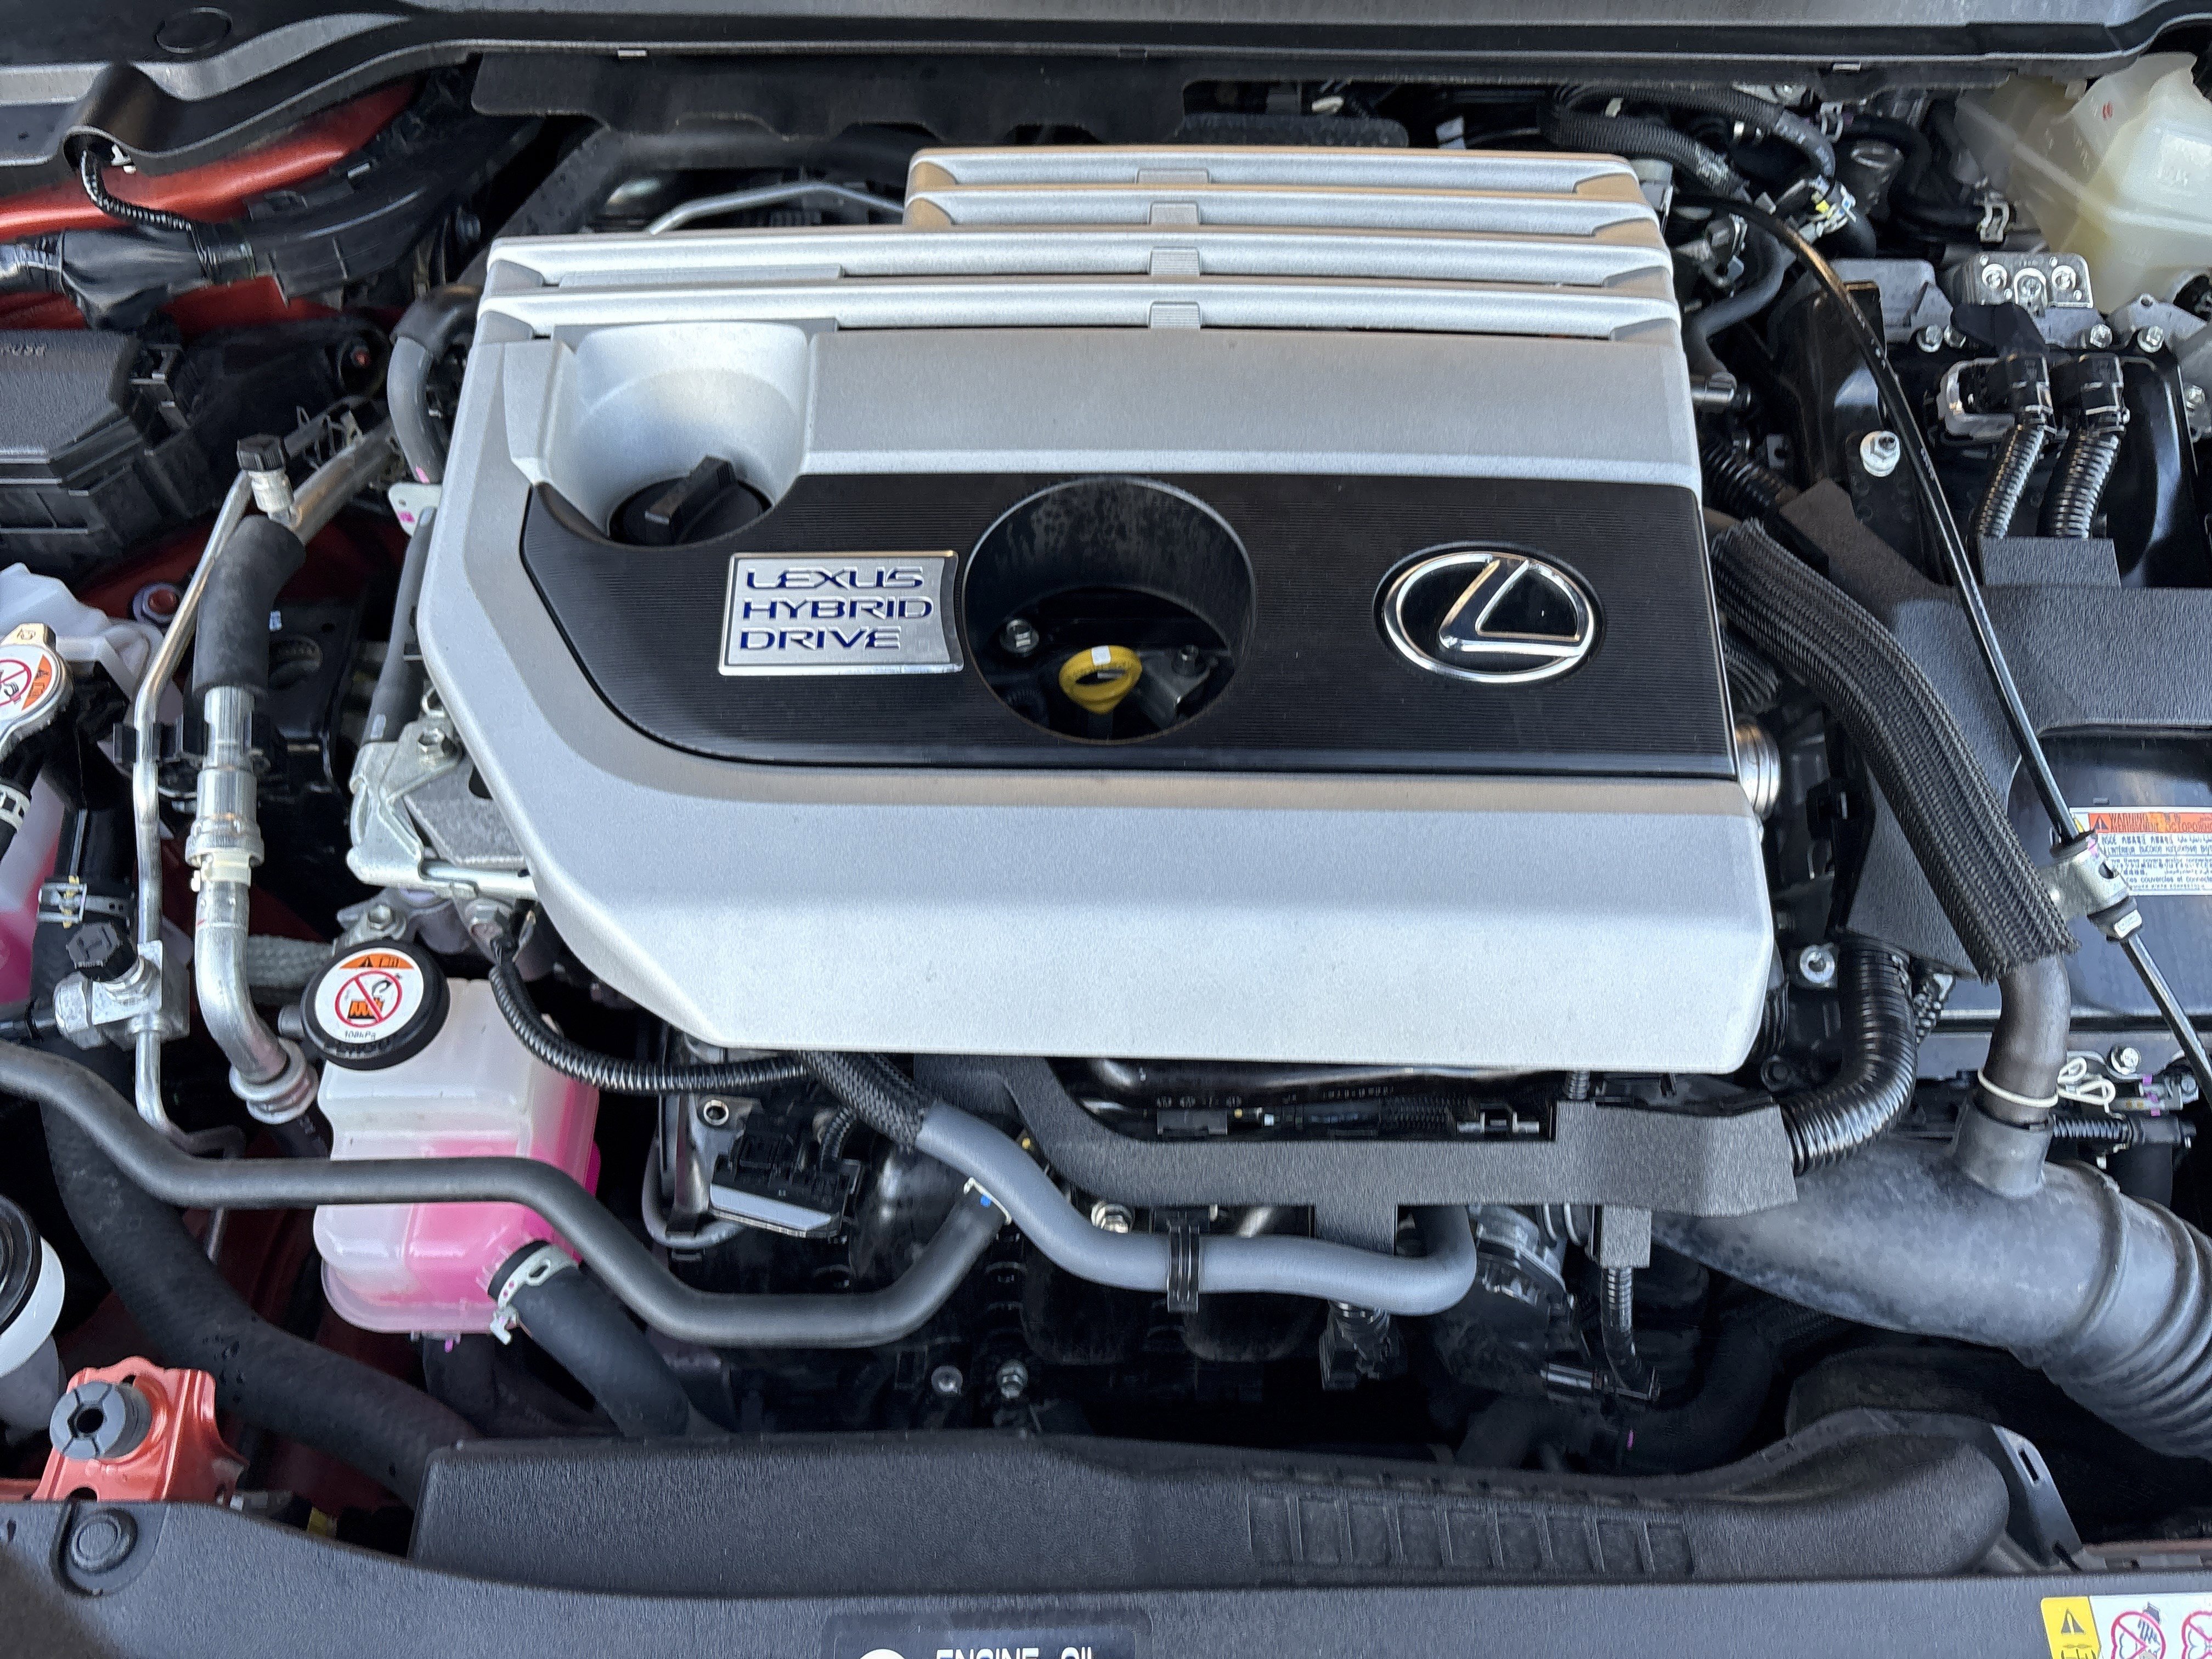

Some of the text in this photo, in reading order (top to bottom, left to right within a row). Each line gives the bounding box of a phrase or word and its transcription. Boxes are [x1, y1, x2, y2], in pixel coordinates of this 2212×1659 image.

[746, 566, 924, 590] LEXUS
[742, 596, 933, 620] HYBRID
[739, 626, 901, 651] DRIVE
